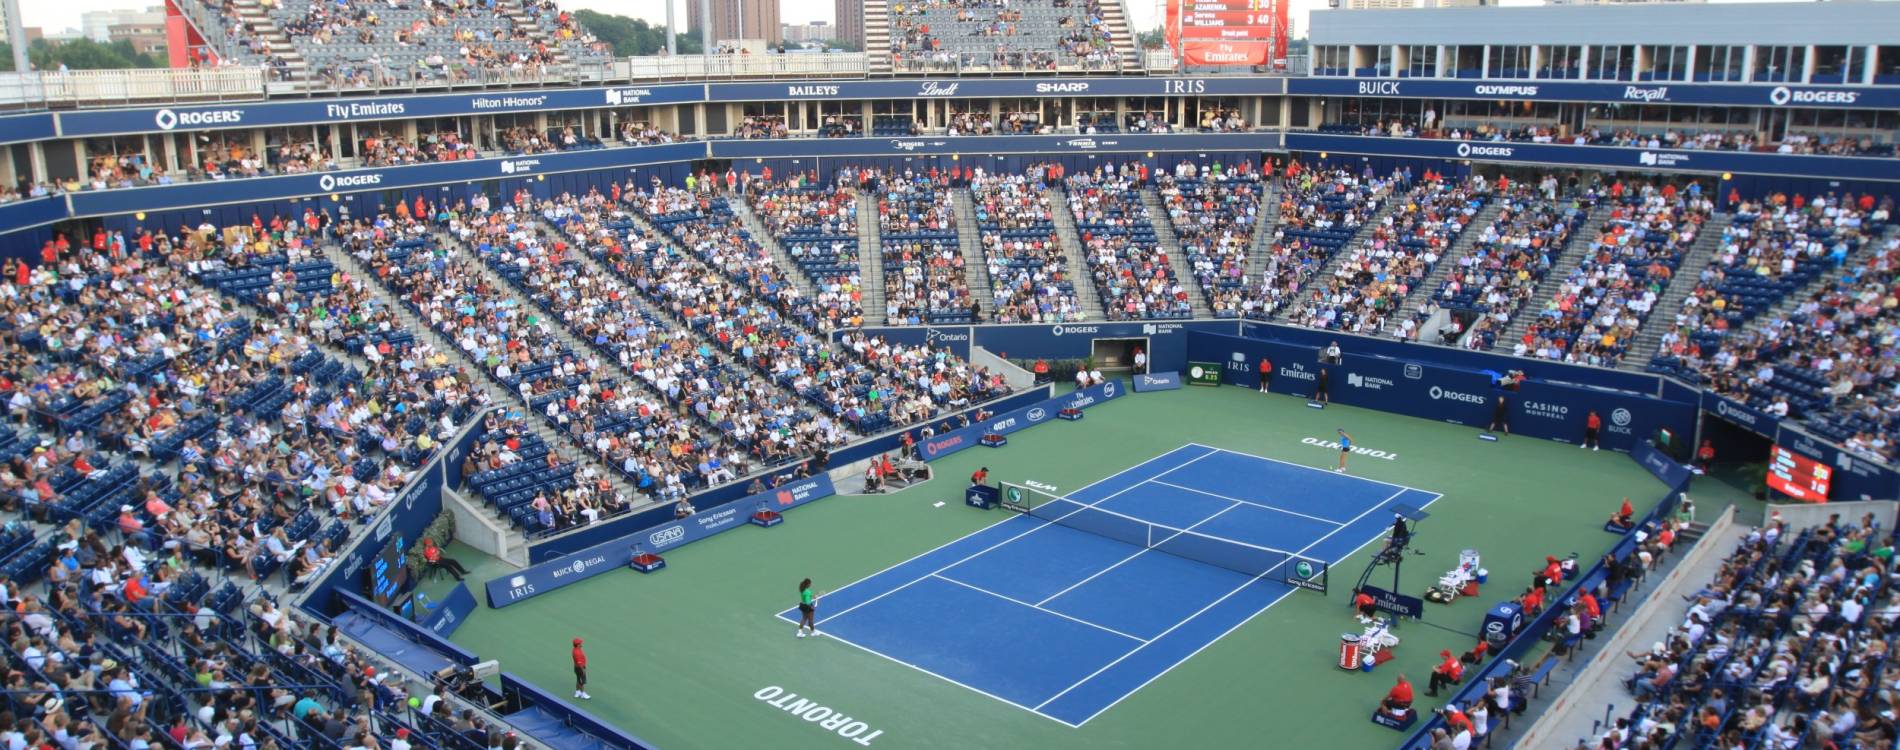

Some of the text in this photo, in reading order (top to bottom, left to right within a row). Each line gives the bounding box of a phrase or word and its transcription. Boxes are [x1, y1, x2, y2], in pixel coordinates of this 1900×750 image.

[1247, 15, 1269, 24] 3 40
[1219, 44, 1232, 52] Fly
[1204, 52, 1248, 62] Emirates
[788, 86, 837, 96] BAILEYS
[918, 81, 959, 96] Lindt
[1036, 82, 1088, 93] SHARP
[1165, 80, 1205, 93] IRIS
[1358, 81, 1400, 95] BUICK
[1475, 85, 1538, 96] OLYMPUS
[1624, 85, 1668, 101] Rexall
[1793, 90, 1857, 103] ROGERS
[472, 98, 501, 109] Hilton
[327, 102, 404, 118] Fly Emirates
[180, 110, 241, 125] ROGERS
[1472, 146, 1512, 156] ROGERS
[337, 175, 381, 187] ROGERS
[1065, 326, 1098, 334] ROGERS
[940, 333, 968, 341] Ontario
[1227, 361, 1250, 372] IRIS
[1293, 362, 1304, 372] Fly
[1280, 367, 1316, 381] Emirates
[1364, 376, 1394, 386] NATIONAL
[1443, 390, 1485, 404] ROGERS
[1524, 400, 1568, 414] CASINO
[1727, 405, 1756, 425] ROGERS
[994, 420, 1006, 431] 407
[1608, 424, 1632, 435] BUICK
[935, 435, 963, 450] ROGERS
[411, 480, 428, 502] ROGERS
[792, 482, 818, 494] NATIONAL
[794, 491, 810, 501] BANK
[698, 508, 736, 525] Sony Ericsson
[652, 527, 682, 543] USANA
[553, 556, 606, 578] BUICK REGAL
[1287, 578, 1325, 591] Sony Ericsson
[509, 584, 535, 600] IRIS
[1385, 593, 1397, 602] Fly
[754, 685, 884, 746] TORONTO
